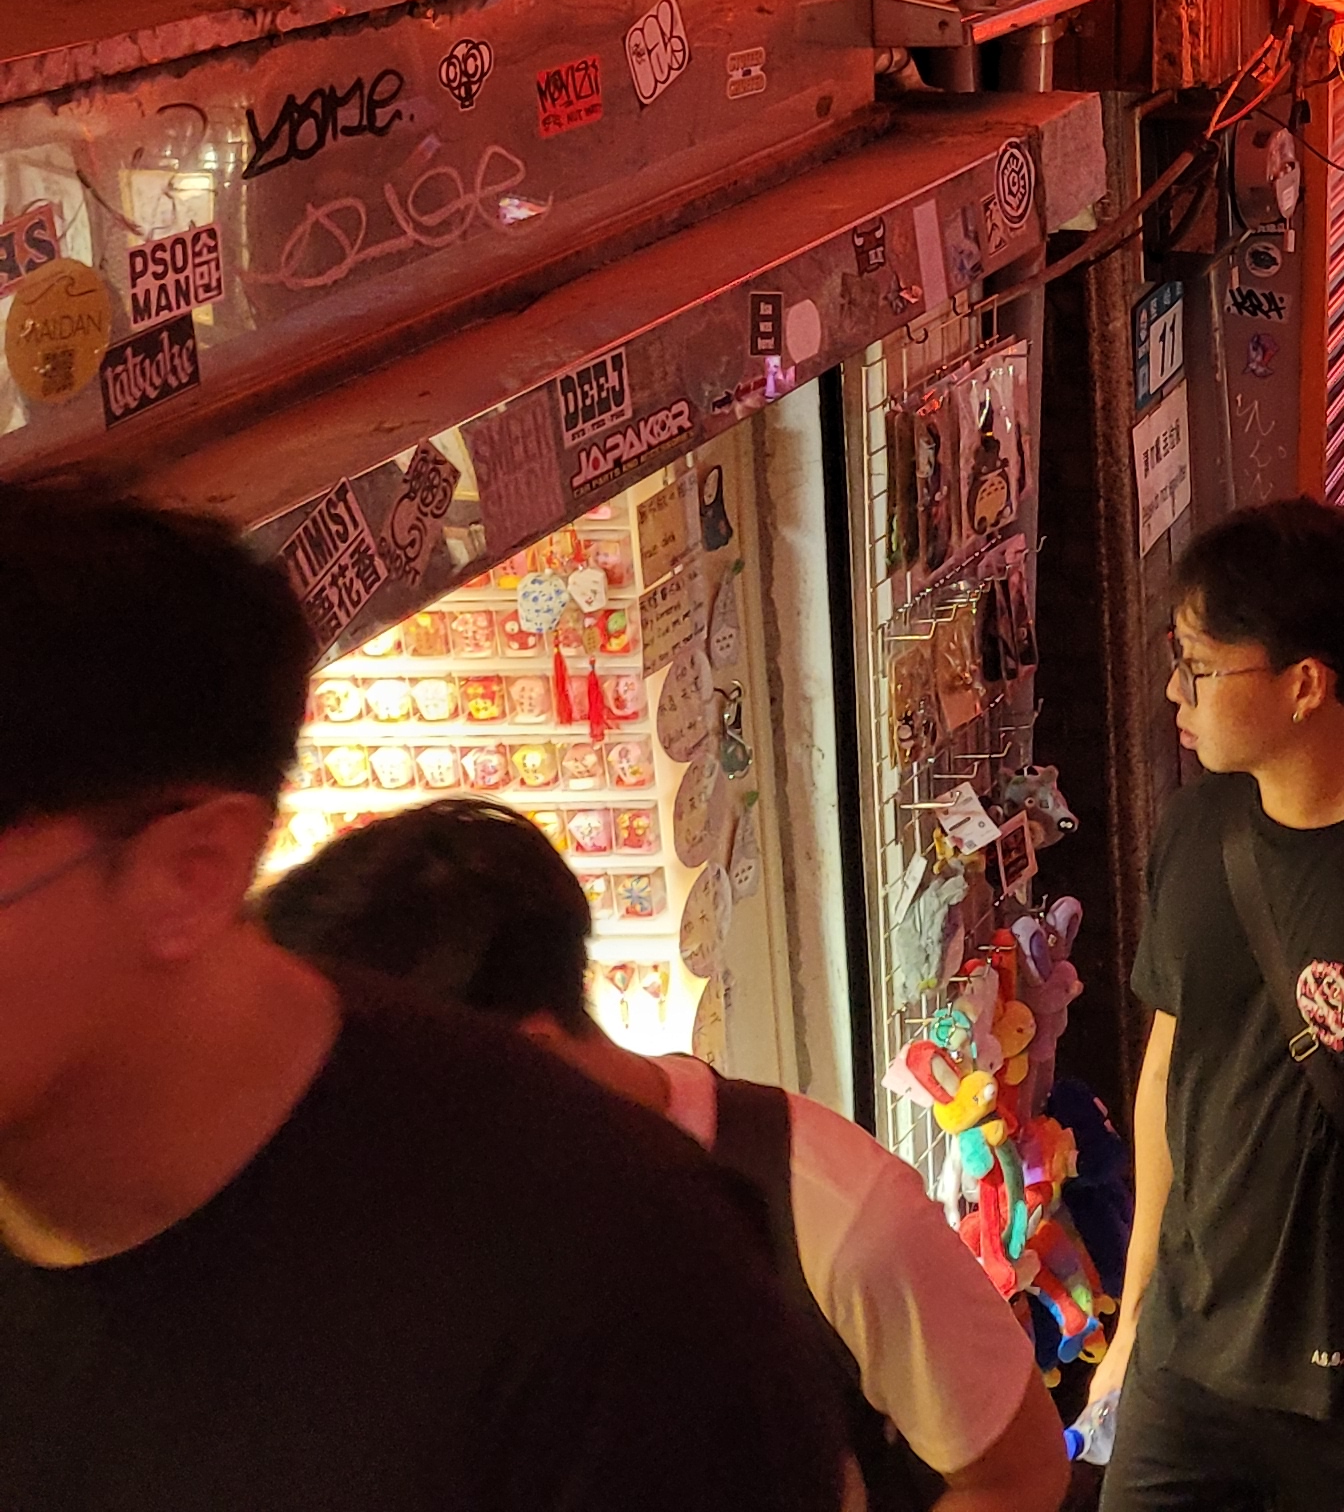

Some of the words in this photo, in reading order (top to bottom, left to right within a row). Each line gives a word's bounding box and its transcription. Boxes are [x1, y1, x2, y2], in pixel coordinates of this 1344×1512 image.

[130, 236, 189, 289] PSO
[131, 274, 191, 325] MAN
[1158, 312, 1177, 378] 11
[559, 351, 626, 433] DEEJ
[281, 480, 361, 591] TIMIST
